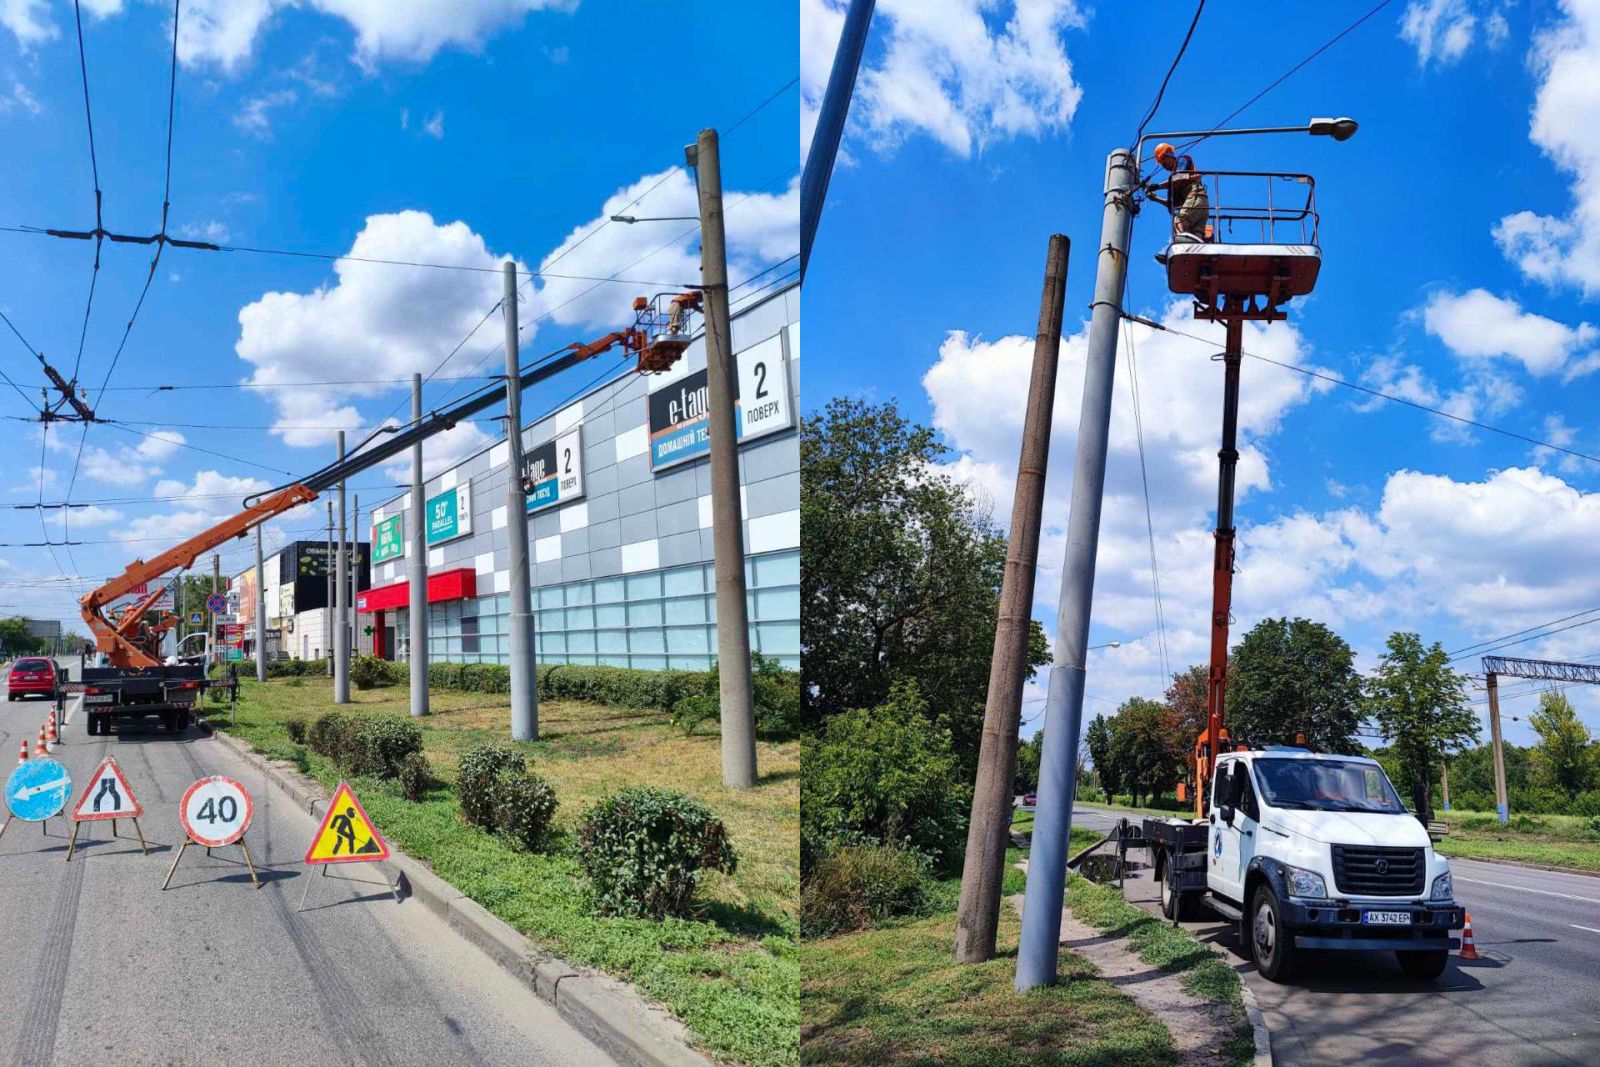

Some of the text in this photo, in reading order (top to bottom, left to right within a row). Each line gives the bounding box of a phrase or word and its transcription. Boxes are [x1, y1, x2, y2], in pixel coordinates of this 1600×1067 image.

[754, 362, 768, 399] 2
[747, 400, 780, 424] ПОВЕРХ
[564, 448, 571, 475] 2
[196, 795, 238, 825] 40
[1369, 912, 1379, 922] AX
[1381, 913, 1398, 923] 3742
